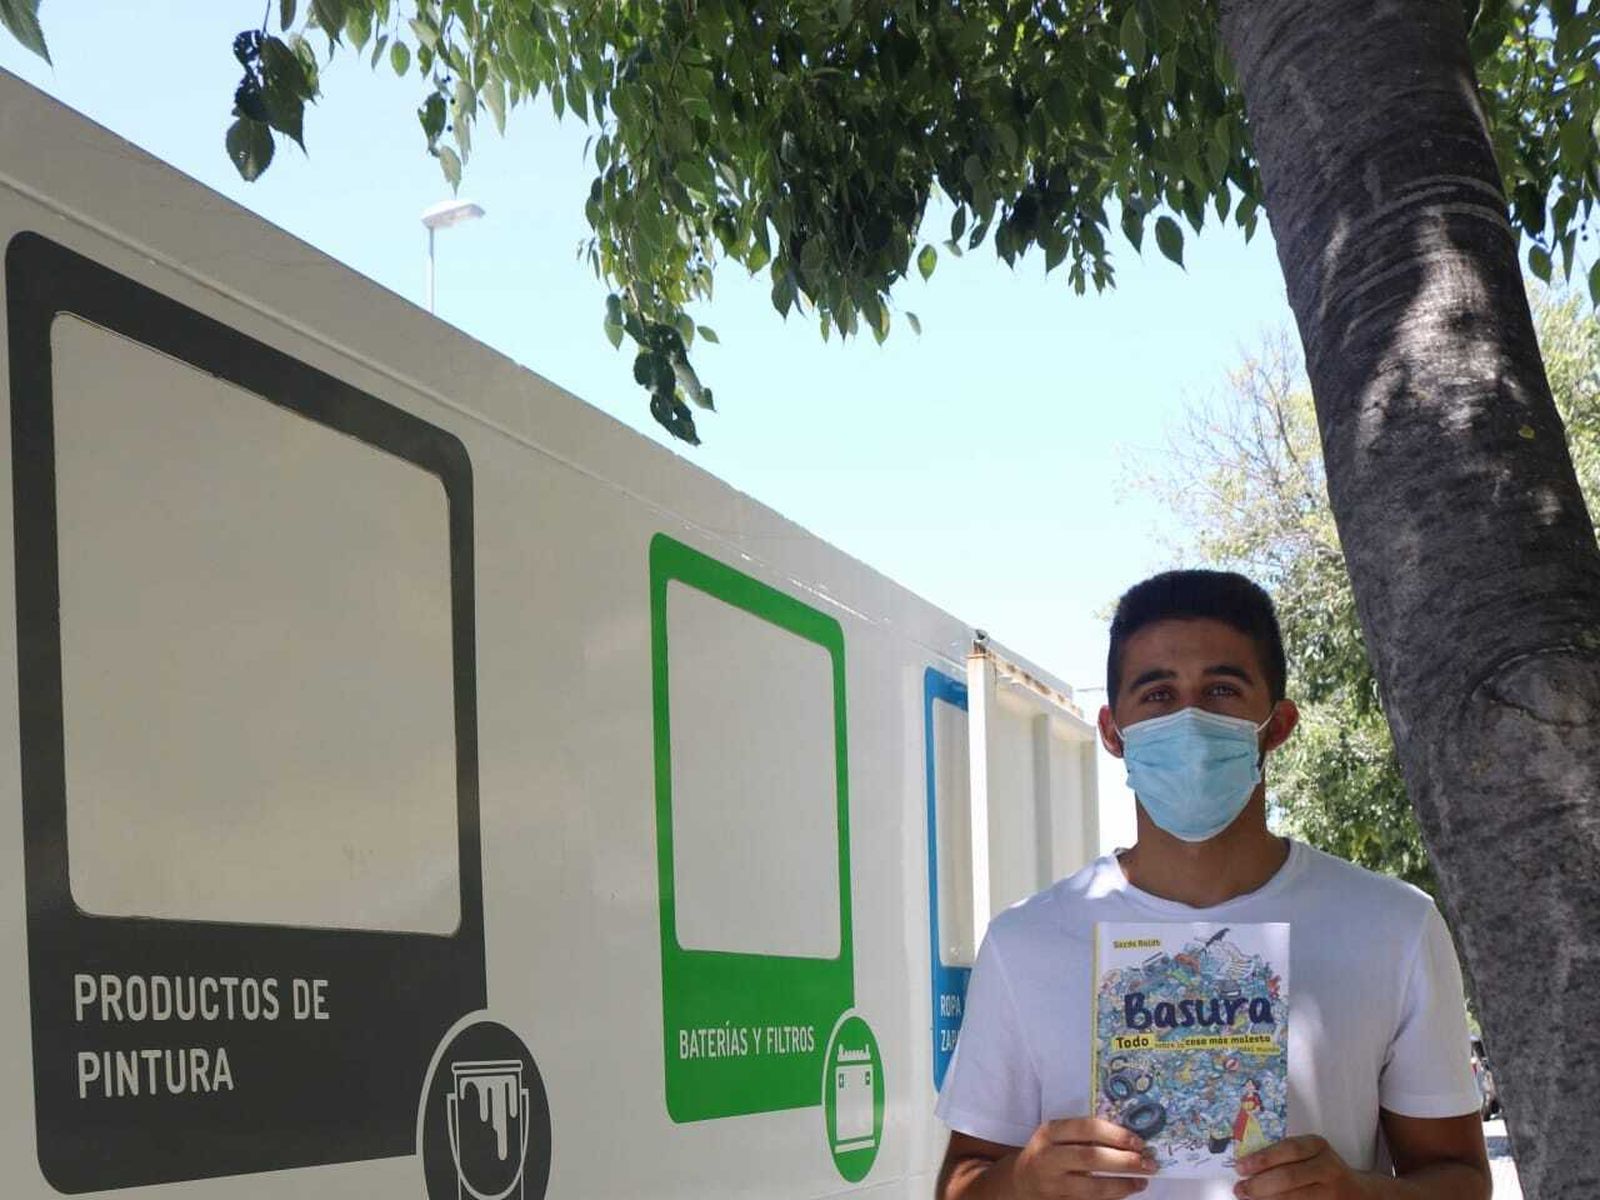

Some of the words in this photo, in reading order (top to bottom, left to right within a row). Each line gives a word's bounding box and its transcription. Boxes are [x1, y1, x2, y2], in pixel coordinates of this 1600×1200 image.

[74, 972, 280, 1022] PRODUCTOS
[293, 978, 330, 1020] DE
[1124, 991, 1274, 1030] Basura
[679, 1020, 748, 1059] BATERÍAS
[753, 1029, 763, 1054] Y
[766, 1026, 815, 1052] FILTROS
[1116, 1036, 1149, 1049] Todo
[77, 1047, 235, 1099] PINTURA
